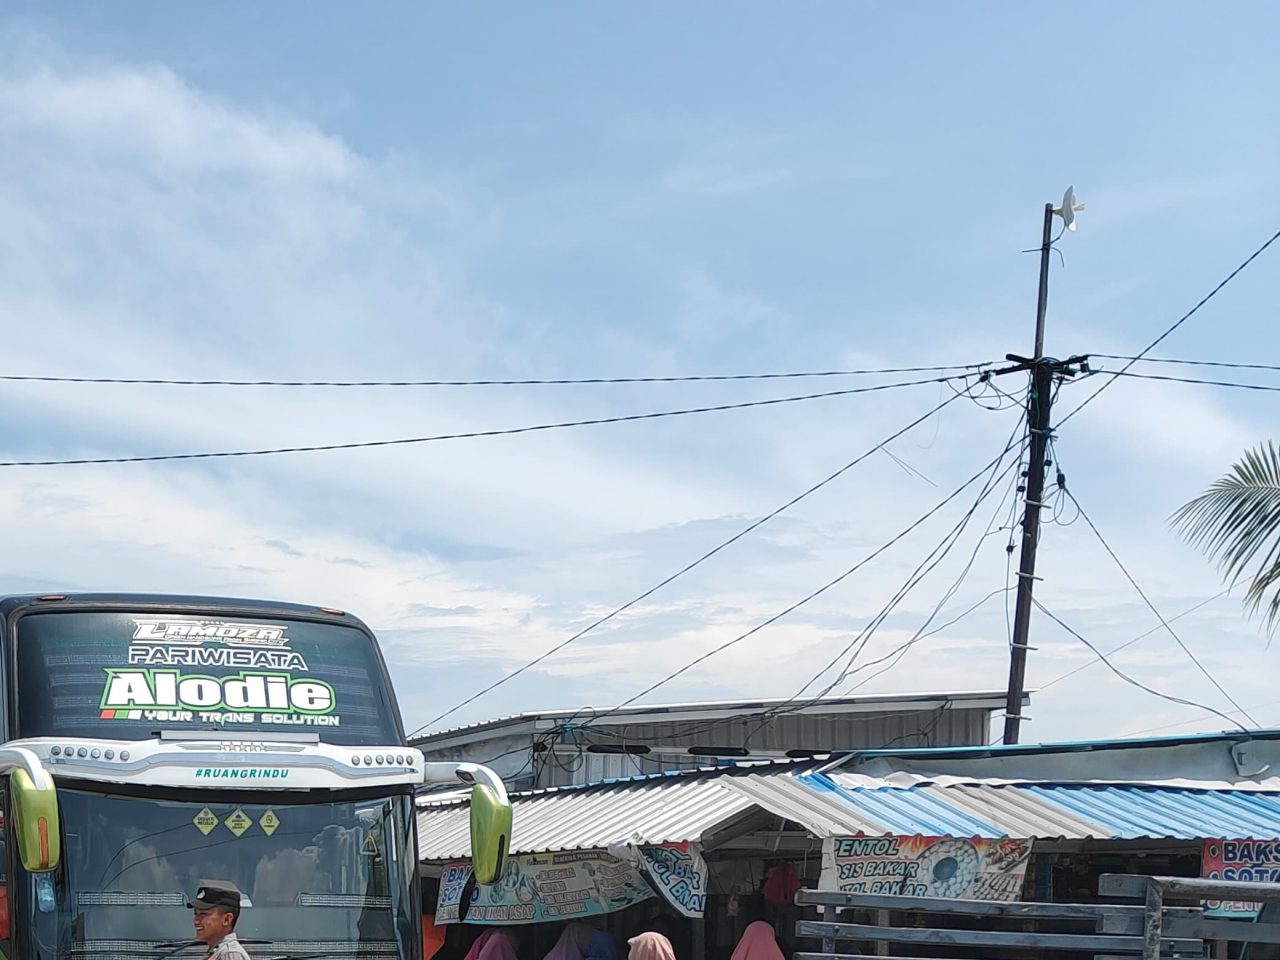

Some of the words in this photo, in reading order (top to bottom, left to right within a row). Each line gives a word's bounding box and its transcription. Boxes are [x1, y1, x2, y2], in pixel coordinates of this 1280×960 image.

[129, 646, 308, 671] PARIWISATA
[103, 670, 335, 712] Alodie
[144, 710, 193, 722] YOUR
[199, 711, 254, 726] TRANS
[261, 713, 340, 726] SOLUTION
[195, 768, 289, 778] #RUANGRINDU
[864, 862, 919, 879] BAKAR
